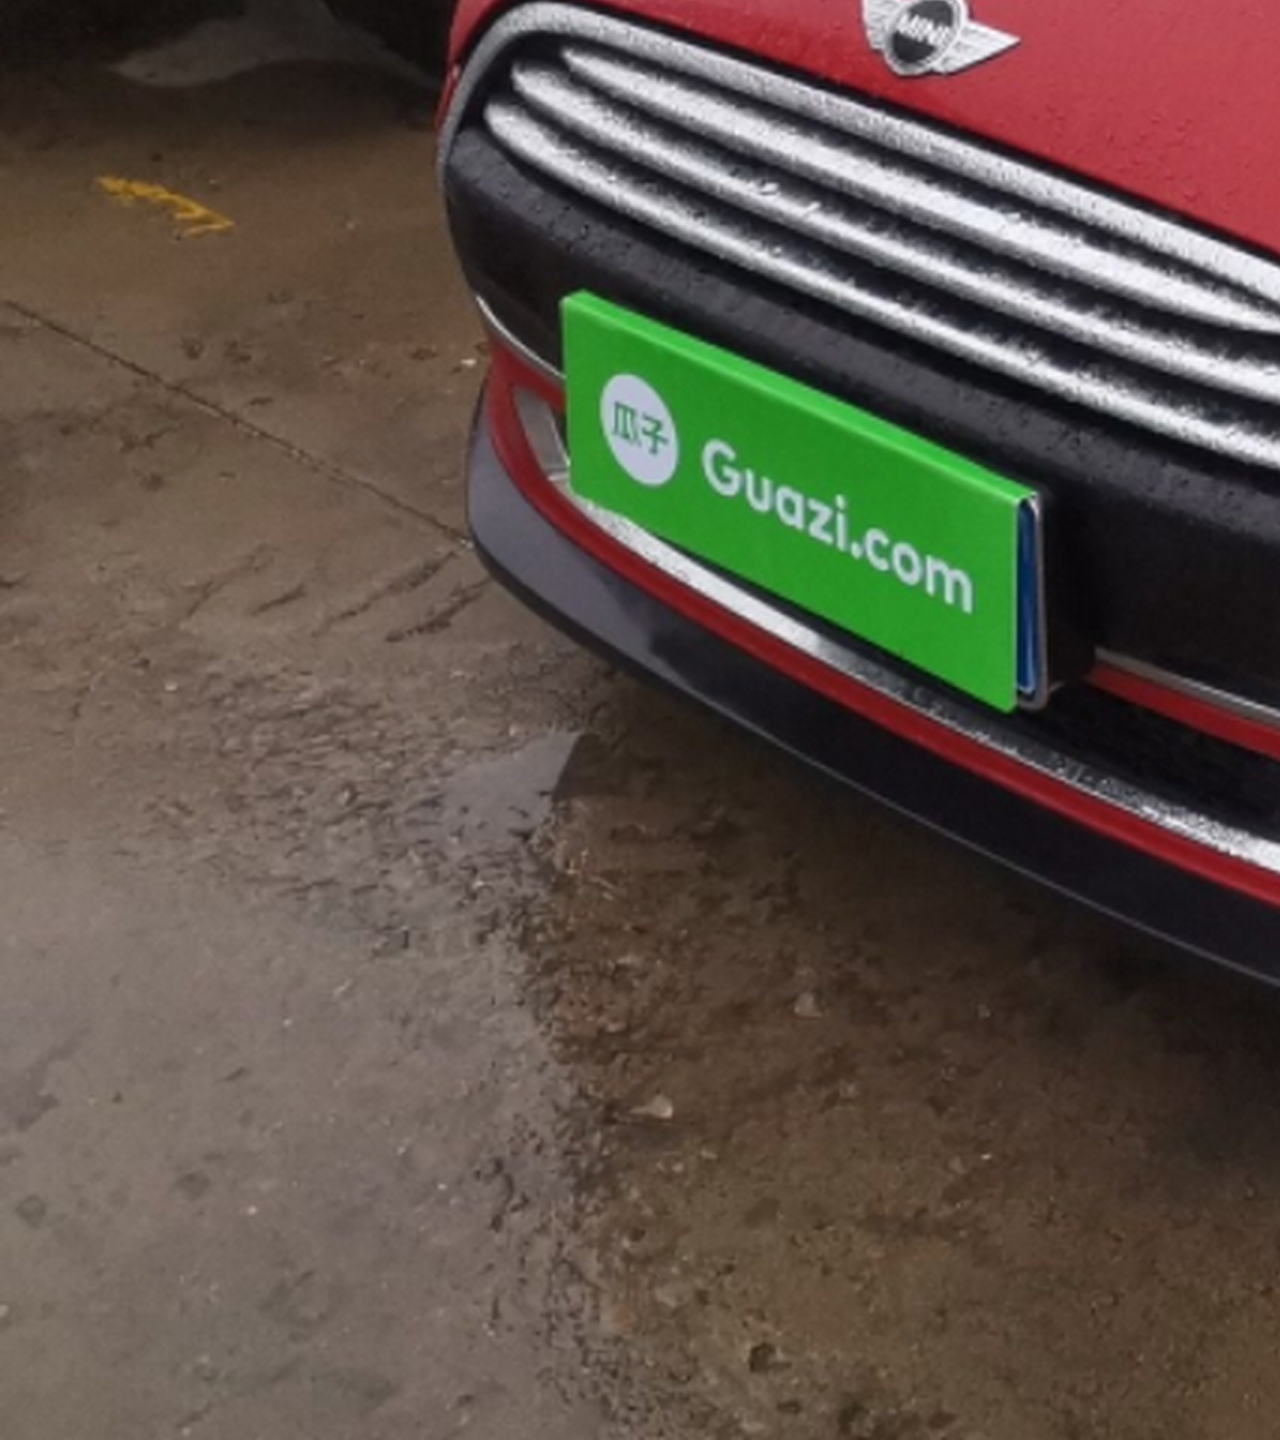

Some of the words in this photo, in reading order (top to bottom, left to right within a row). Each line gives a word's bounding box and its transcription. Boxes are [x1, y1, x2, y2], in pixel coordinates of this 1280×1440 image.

[897, 12, 951, 48] MINI
[612, 401, 670, 455] 瓜子
[702, 438, 974, 615] Guazi.com
